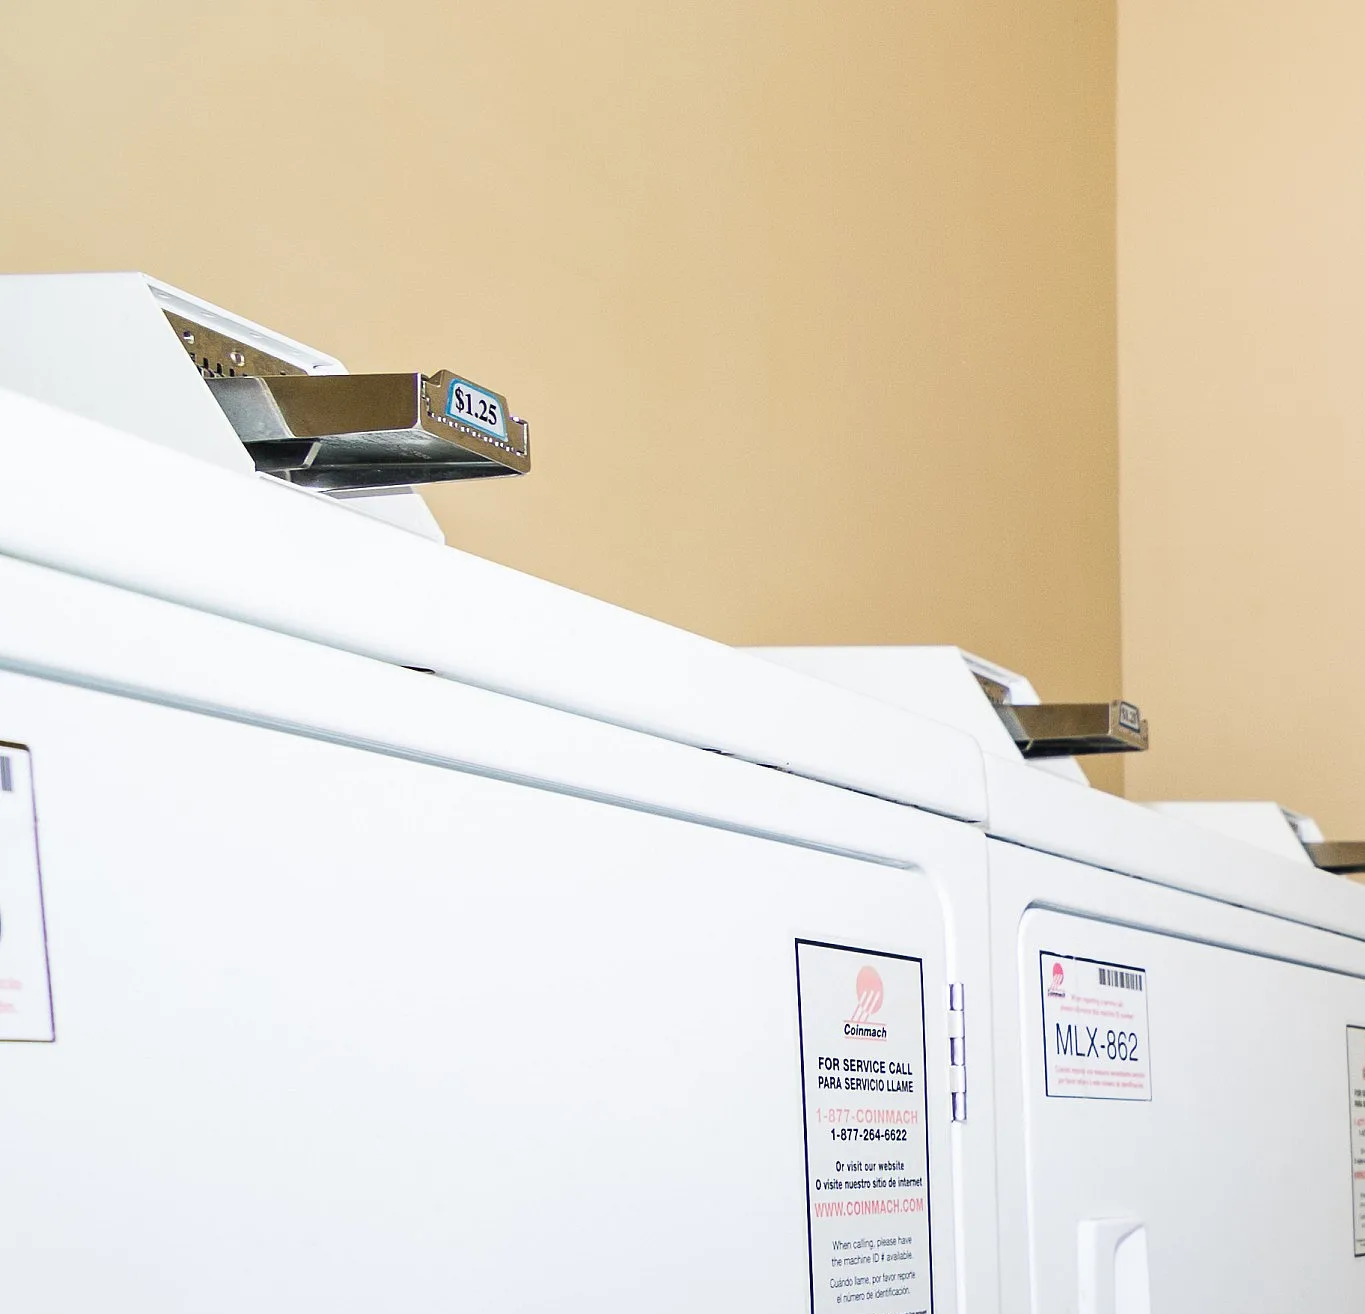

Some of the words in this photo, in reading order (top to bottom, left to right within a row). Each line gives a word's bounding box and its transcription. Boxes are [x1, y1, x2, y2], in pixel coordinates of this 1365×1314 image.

[455, 387, 498, 426] $1.25
[844, 1023, 887, 1038] Coinmach
[1055, 1022, 1139, 1062] MLX-862
[818, 1056, 840, 1071] FOR
[843, 1058, 886, 1074] SERVICE
[888, 1061, 913, 1076] CALL
[818, 1076, 842, 1090] PARA
[844, 1077, 885, 1092] SERVICIO
[886, 1080, 914, 1093] LLAME
[816, 1108, 918, 1124] 1-877-COINMACH
[831, 1128, 907, 1141] 1-877-264-6622
[836, 1160, 844, 1172] Or
[847, 1161, 862, 1172] visit
[864, 1163, 876, 1172] our
[878, 1160, 905, 1171] website
[815, 1179, 822, 1190] O
[823, 1178, 843, 1190] visite
[844, 1179, 871, 1189] nuestro
[872, 1177, 887, 1189] sitio
[888, 1176, 896, 1188] de
[897, 1177, 923, 1187] internet
[814, 1198, 924, 1218] WWW.COINMACH.COM
[832, 1240, 852, 1251] When
[853, 1238, 875, 1250] calling,
[876, 1237, 897, 1248] please
[898, 1235, 912, 1245] have
[831, 1258, 842, 1267] the
[843, 1255, 871, 1266] machine
[872, 1253, 880, 1263] ID
[872, 1274, 882, 1284] por
[883, 1273, 897, 1283] favor
[897, 1271, 916, 1282] reporte
[836, 1294, 842, 1304] el
[843, 1292, 865, 1303] número
[866, 1290, 874, 1300] de
